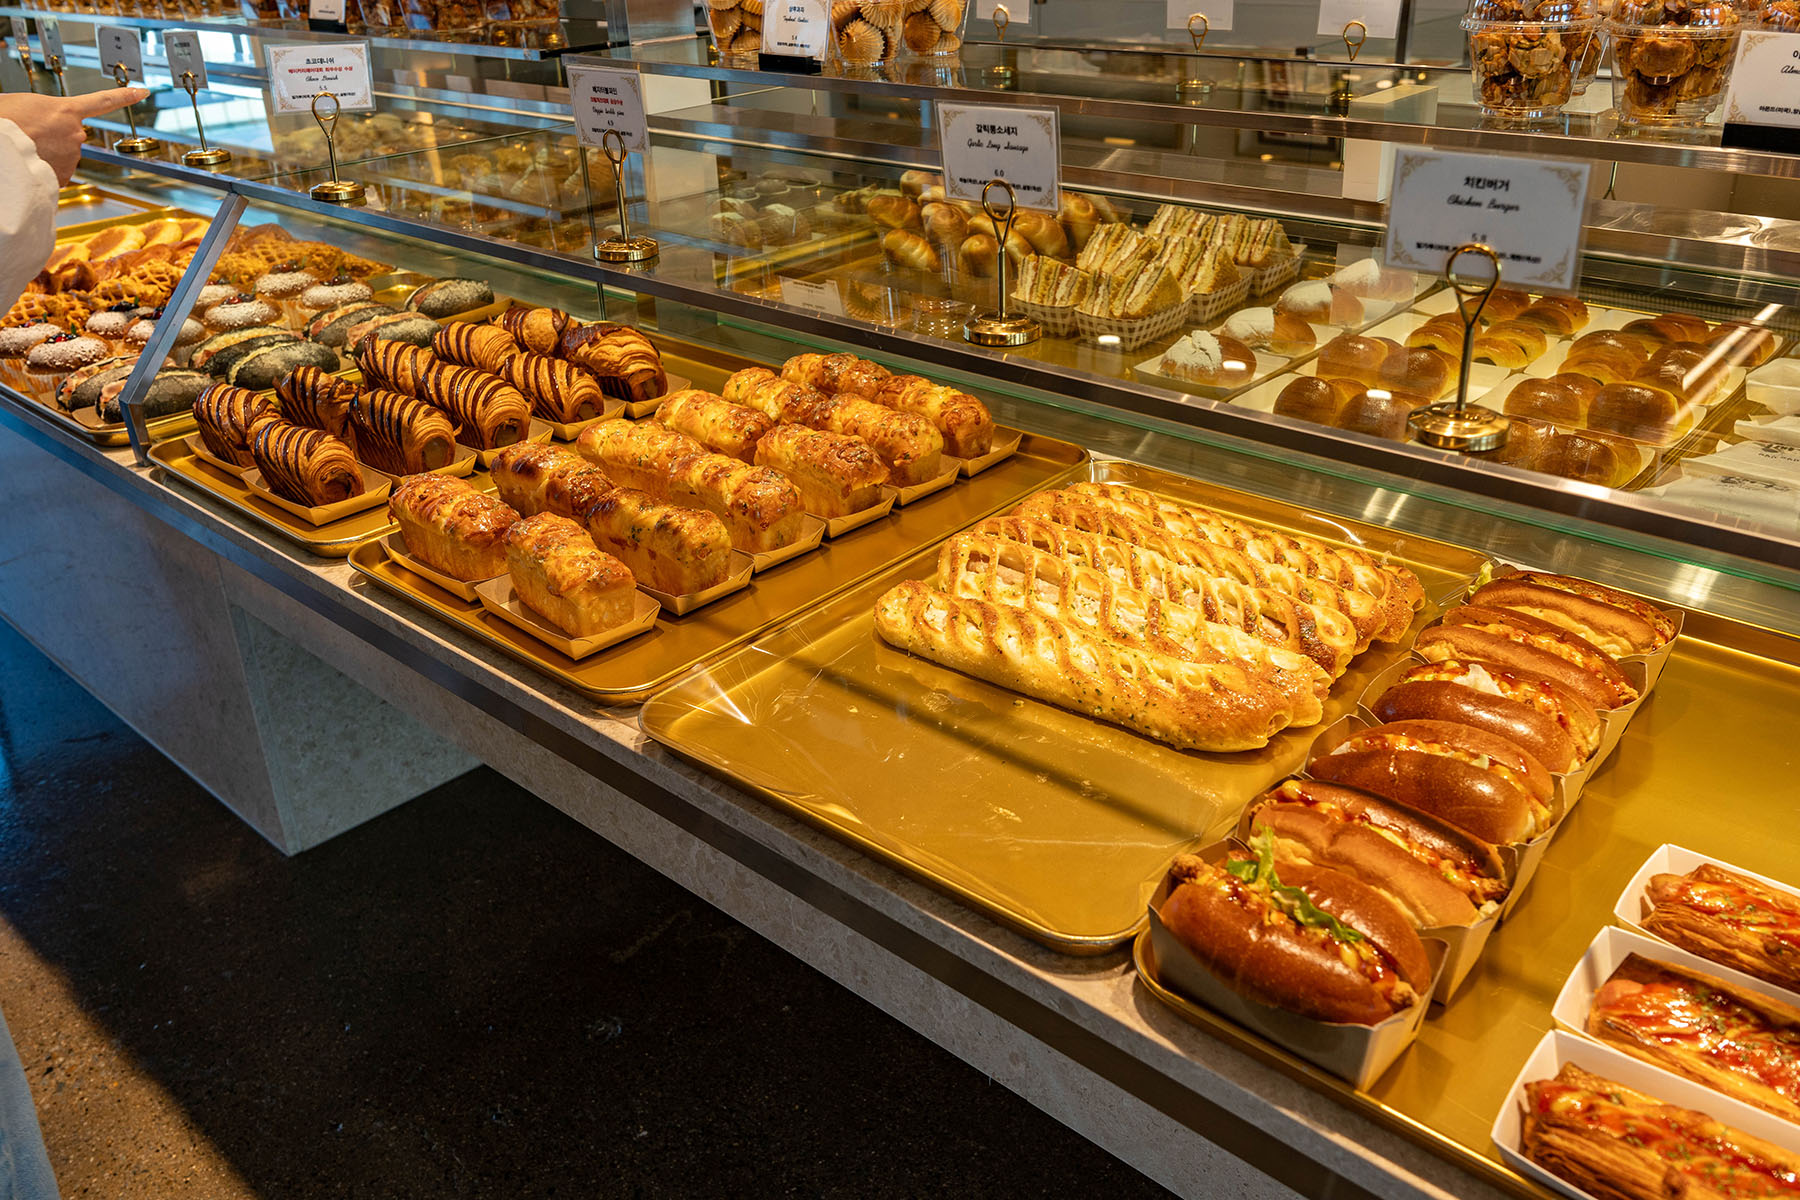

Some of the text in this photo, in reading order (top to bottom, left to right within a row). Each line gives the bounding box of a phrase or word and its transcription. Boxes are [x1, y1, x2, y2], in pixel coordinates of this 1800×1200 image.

[1463, 176, 1510, 192] 치킨버거
[1447, 194, 1520, 214] Chicken Burger
